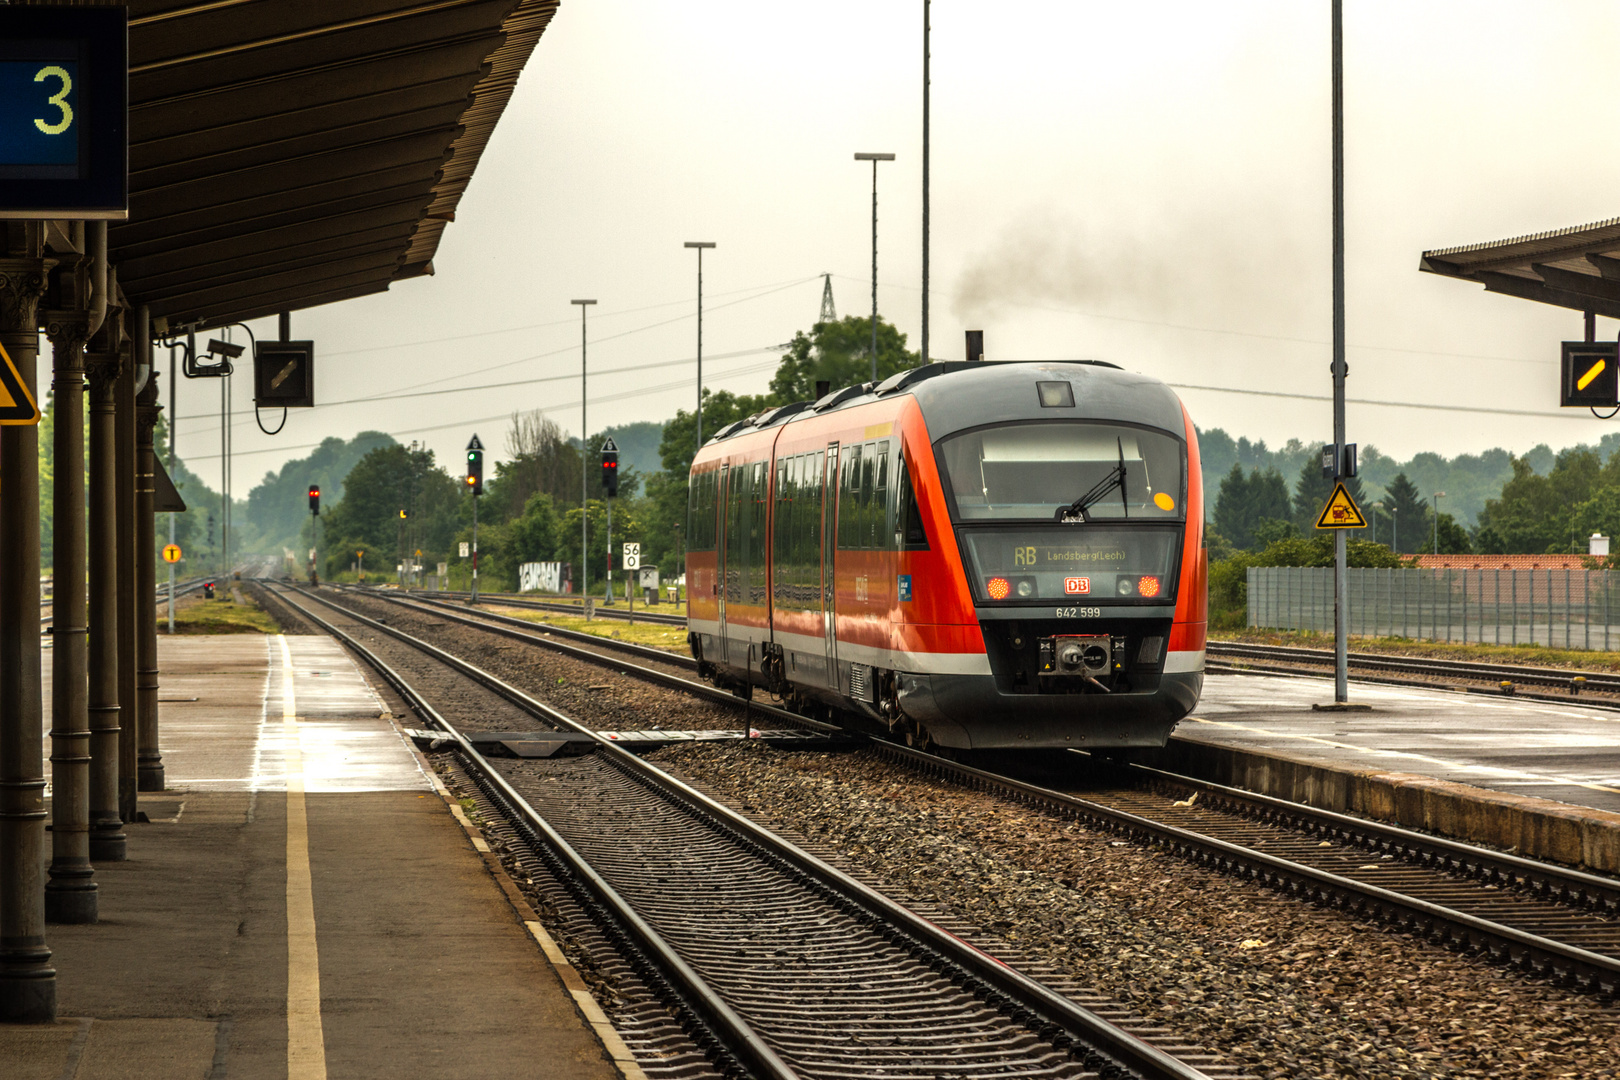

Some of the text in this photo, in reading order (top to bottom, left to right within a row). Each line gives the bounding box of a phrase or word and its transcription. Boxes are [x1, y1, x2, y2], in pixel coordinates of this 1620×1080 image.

[34, 66, 73, 135] 3
[607, 441, 613, 450] 6
[624, 544, 639, 555] 56
[627, 556, 636, 567] 0
[1015, 546, 1126, 566] RB Landsberg(Lech)
[1066, 579, 1089, 593] DB
[1056, 608, 1101, 618] 642 599
